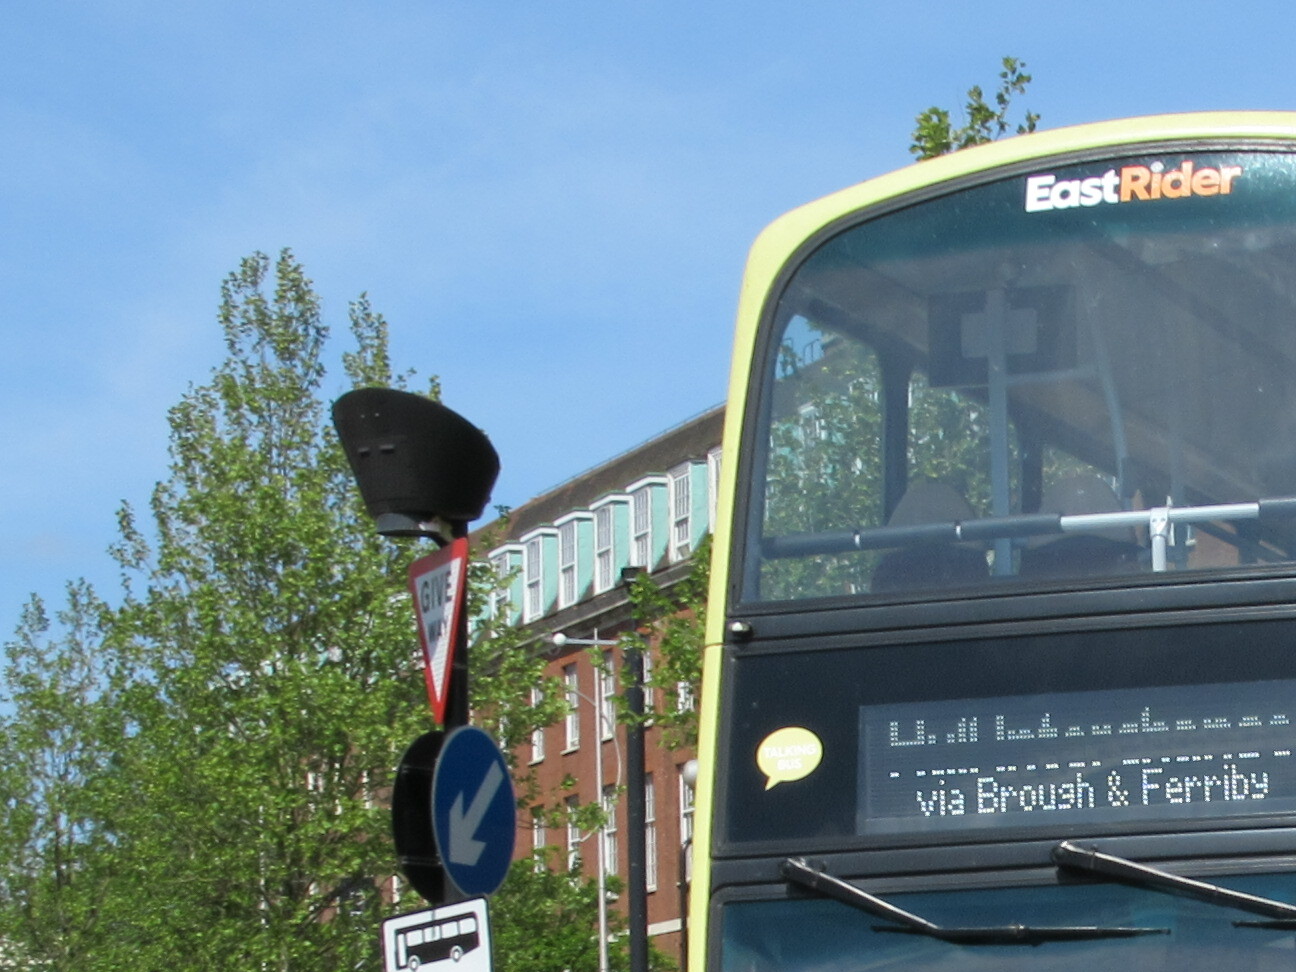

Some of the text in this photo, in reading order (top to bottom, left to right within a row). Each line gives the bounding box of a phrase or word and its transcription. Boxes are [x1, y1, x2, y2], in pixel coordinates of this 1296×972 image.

[421, 570, 453, 614] GIVE
[427, 615, 450, 643] WAY
[763, 743, 819, 759] TALKING
[916, 763, 1269, 816] via Brough & Ferriby
